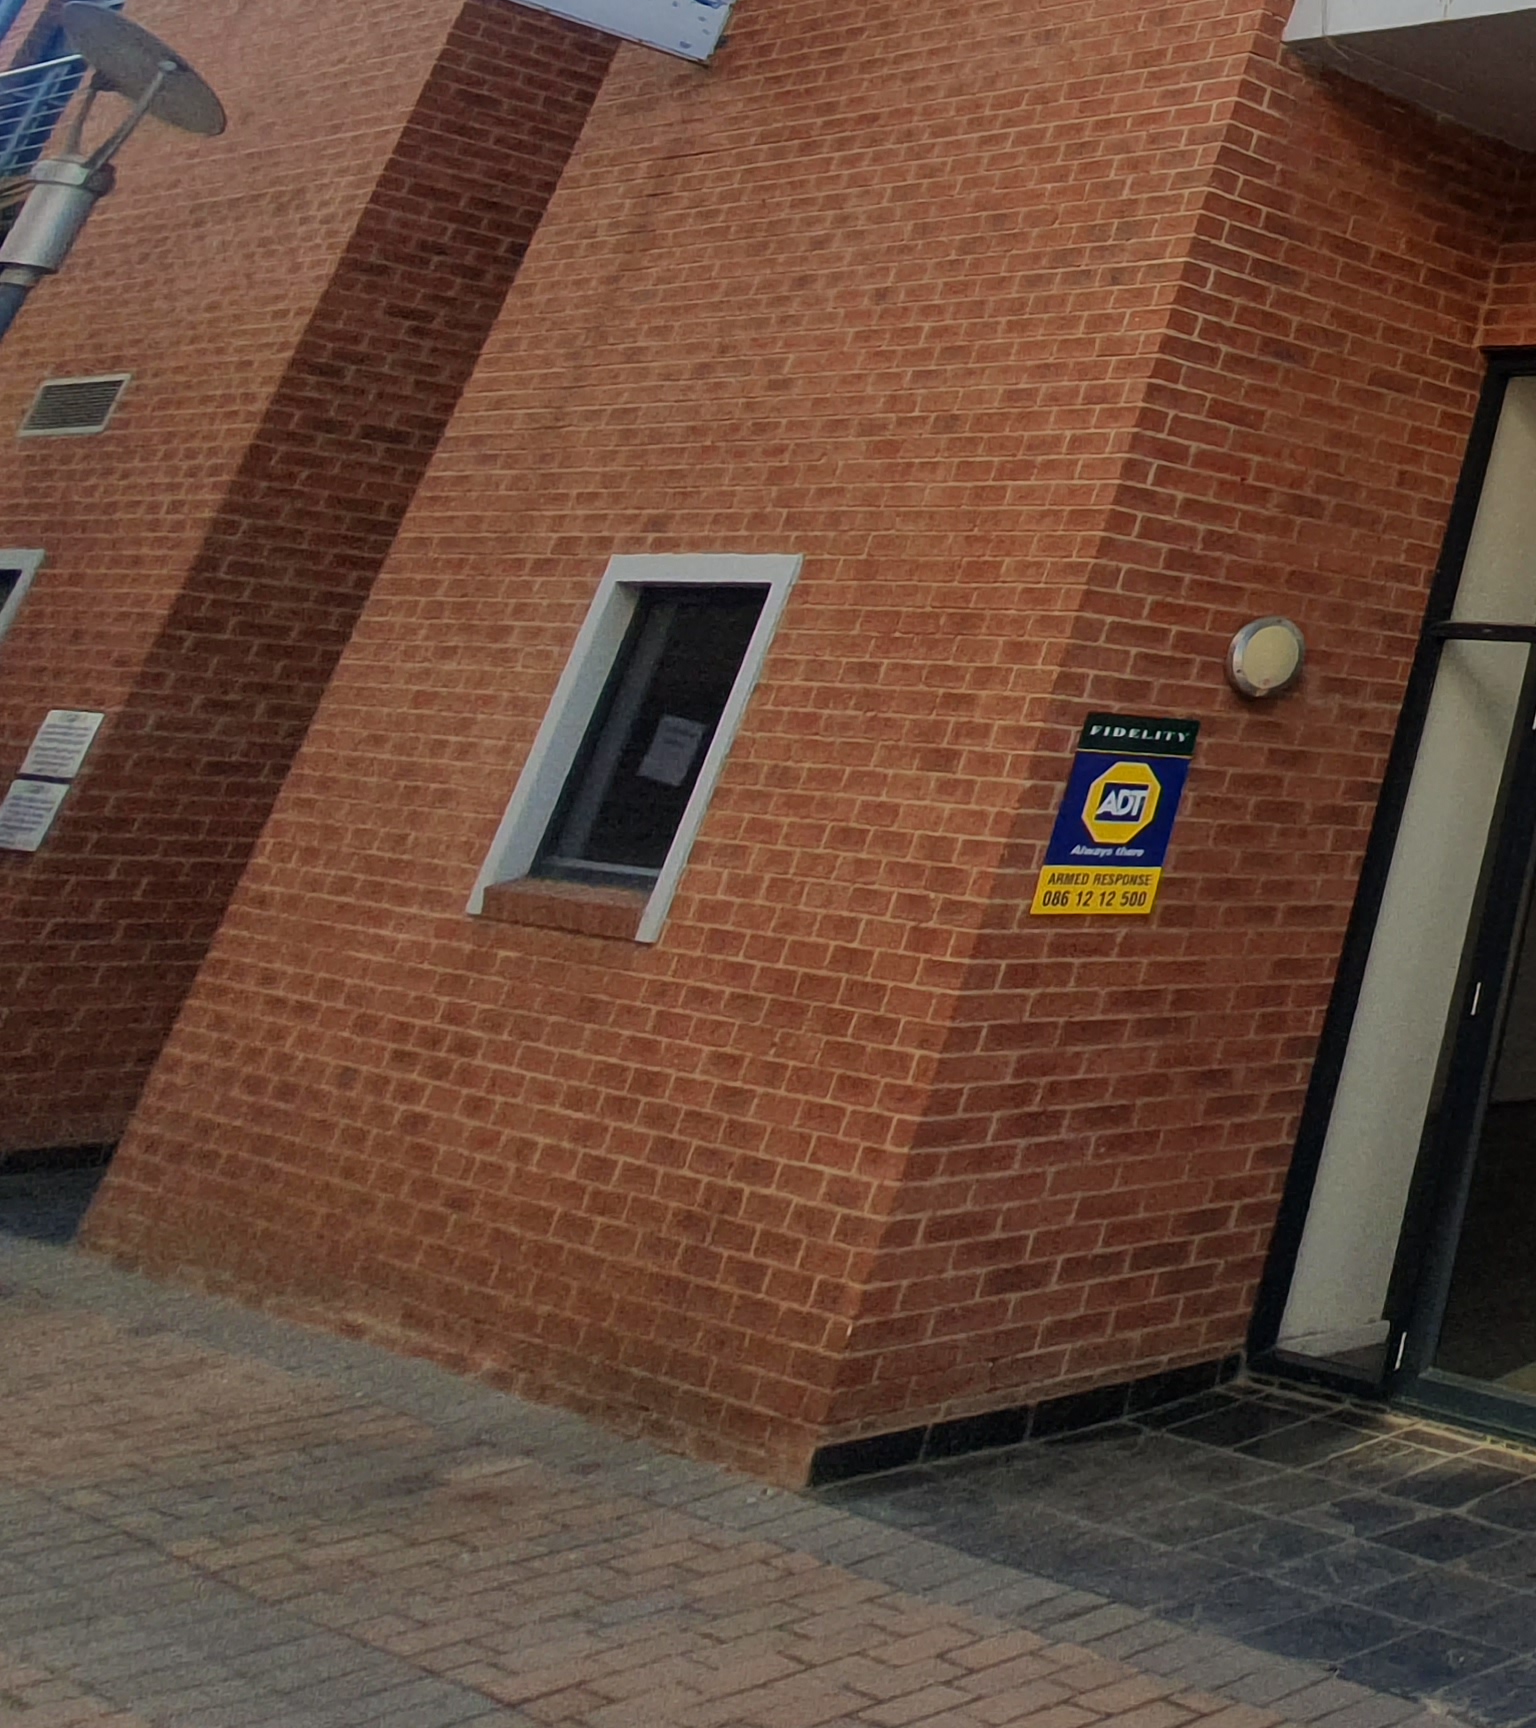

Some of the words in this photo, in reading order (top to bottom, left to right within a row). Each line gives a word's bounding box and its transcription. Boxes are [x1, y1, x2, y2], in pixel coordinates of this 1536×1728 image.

[1090, 725, 1190, 743] FIDELITY
[1096, 788, 1149, 816] ADT
[1047, 873, 1090, 886] ARMED
[1093, 873, 1153, 887] RESPONSE
[1042, 890, 1070, 907] 086
[1075, 891, 1093, 907] 12
[1098, 891, 1117, 907] 12
[1120, 892, 1147, 907] 500
